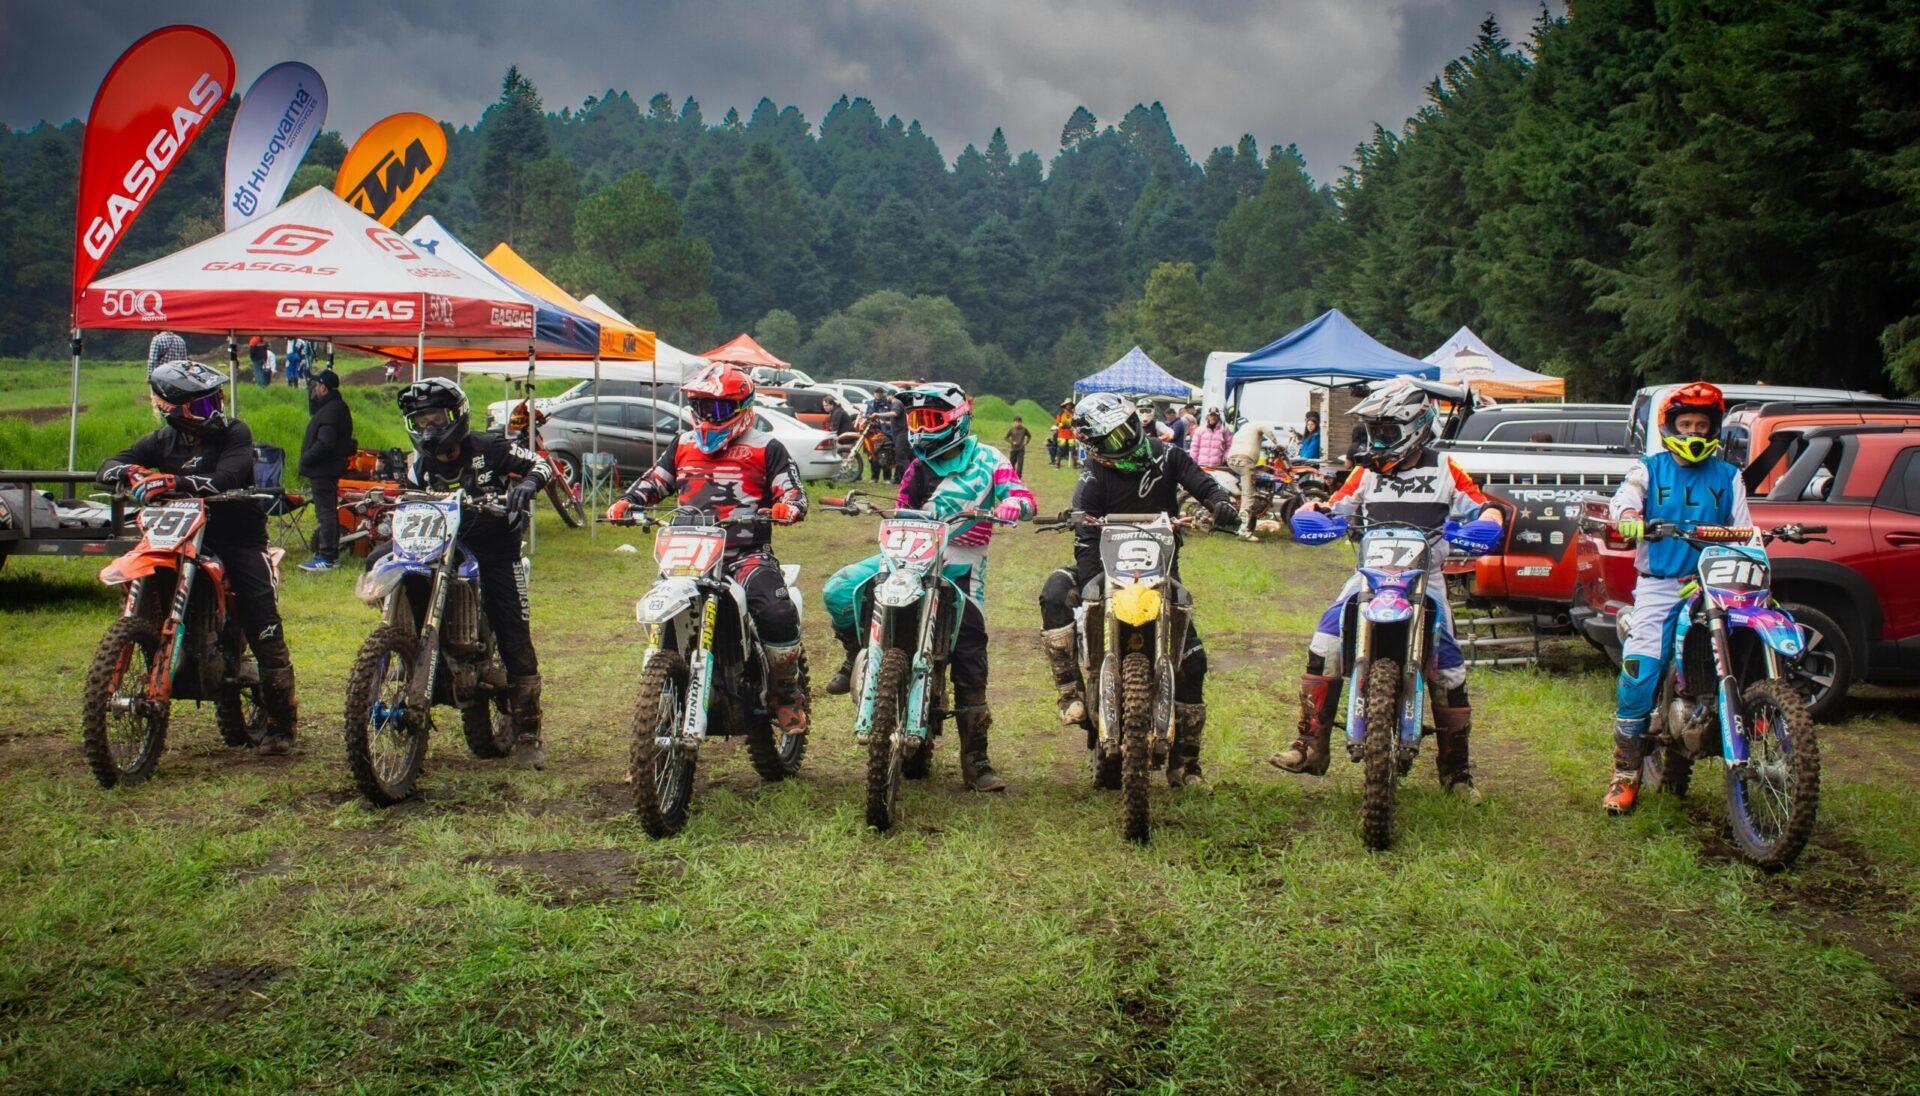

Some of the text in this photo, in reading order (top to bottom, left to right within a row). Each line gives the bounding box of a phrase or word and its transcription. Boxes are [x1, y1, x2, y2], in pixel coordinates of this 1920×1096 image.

[248, 88, 310, 192] Husqvarna
[83, 73, 222, 260] GASGAS
[202, 262, 339, 276] GASGAS
[275, 298, 415, 320] GASGAS
[490, 308, 532, 328] GASGAS
[1657, 485, 1725, 508] FLY
[143, 510, 200, 538] 791
[401, 514, 445, 539] 211
[661, 537, 717, 571] 21
[886, 530, 933, 558] 97
[1364, 540, 1425, 567] 57
[1451, 538, 1489, 550] ACERBIS
[1707, 560, 1766, 587] 211
[688, 671, 703, 728] DUNLOP
